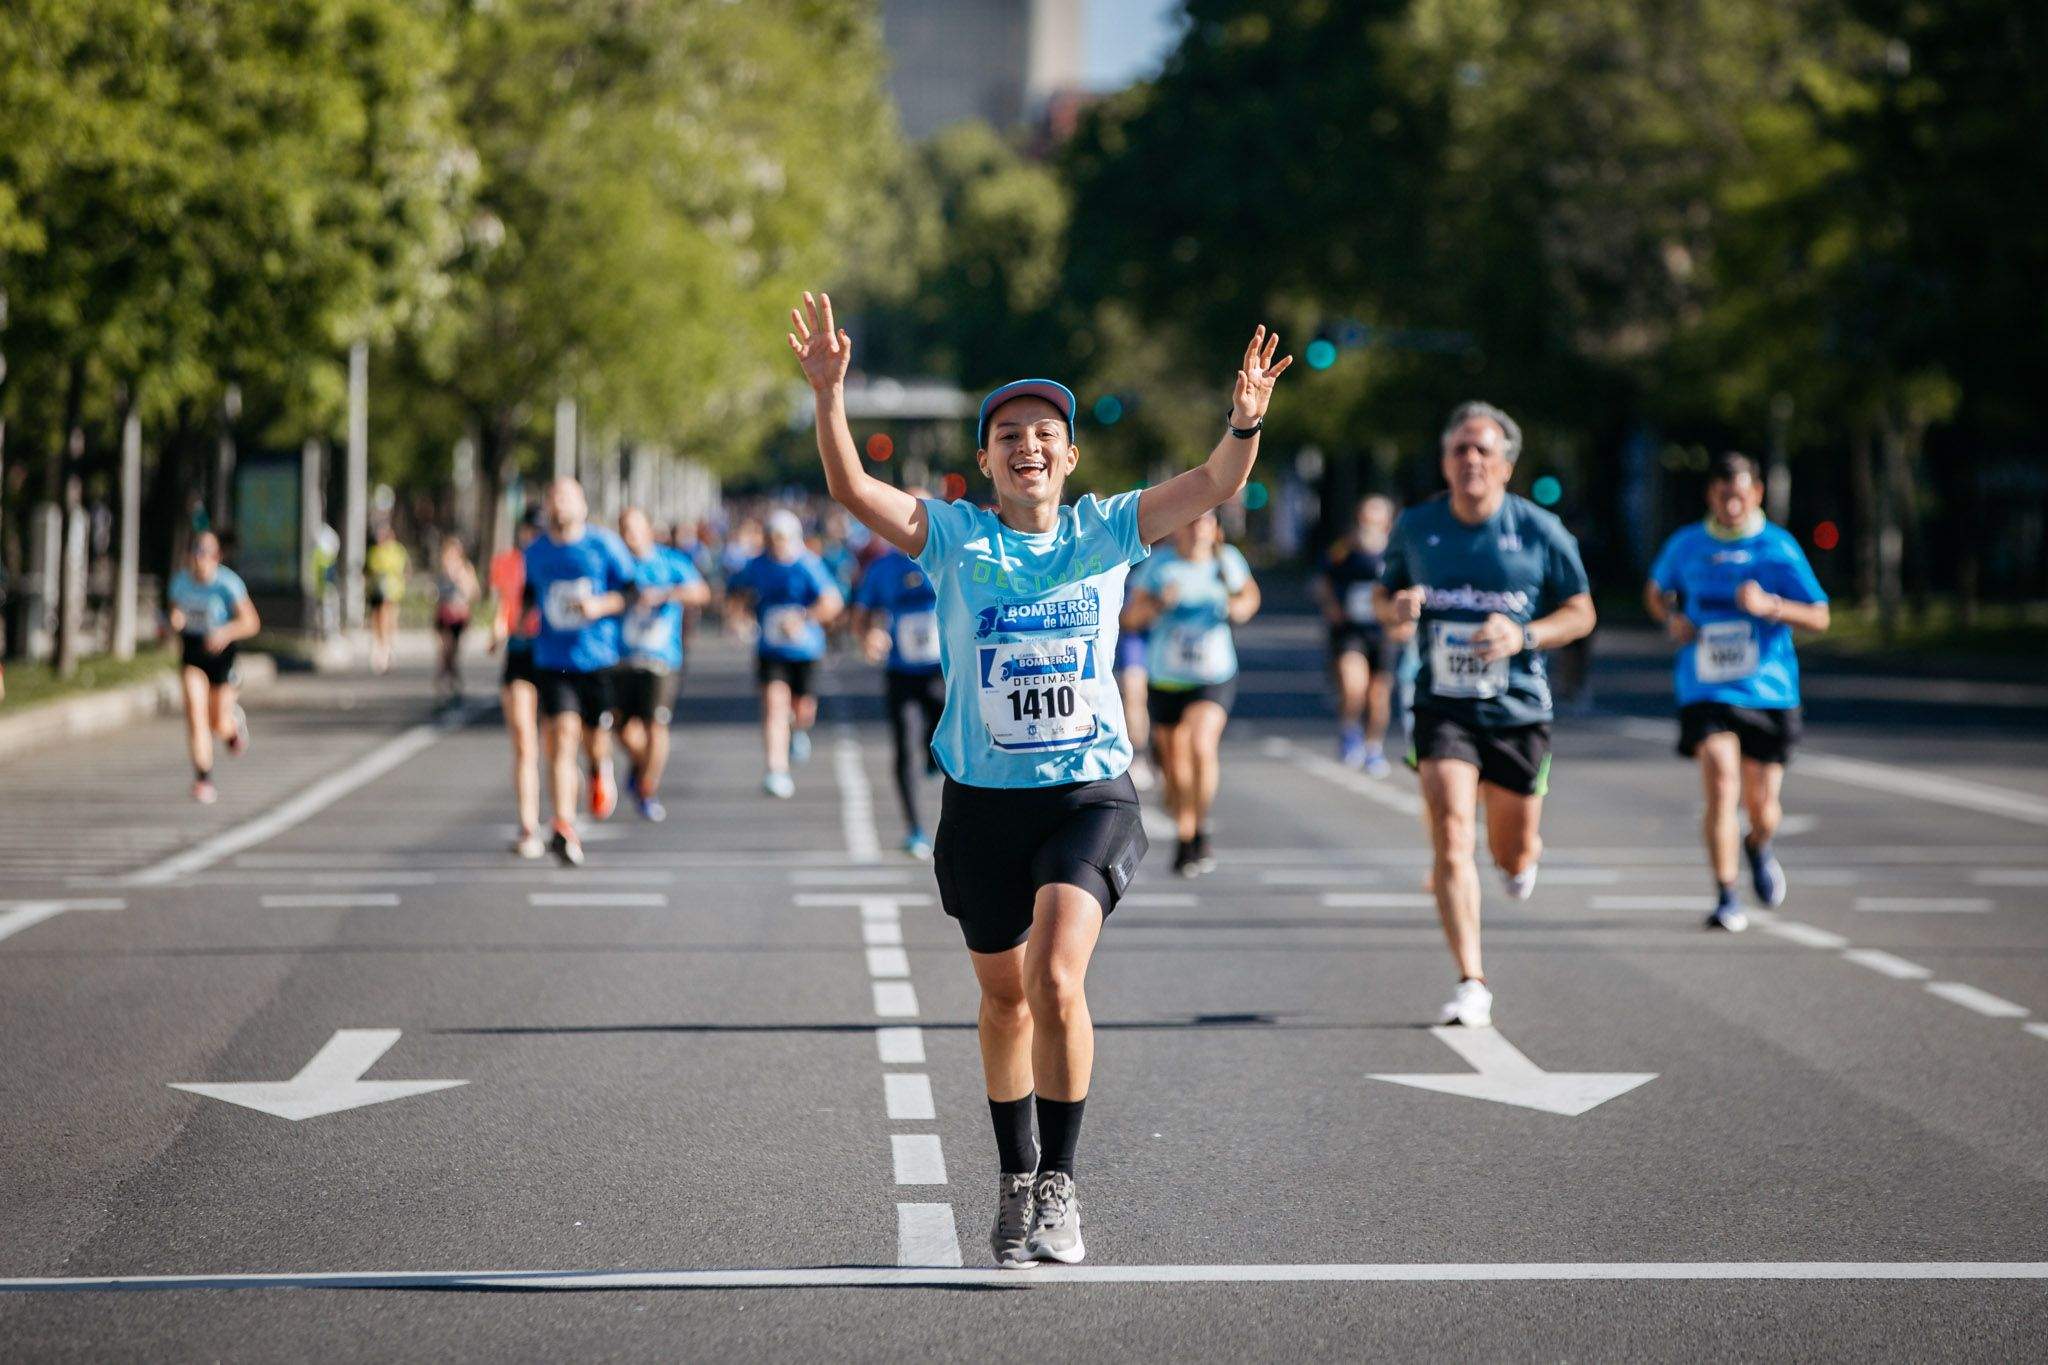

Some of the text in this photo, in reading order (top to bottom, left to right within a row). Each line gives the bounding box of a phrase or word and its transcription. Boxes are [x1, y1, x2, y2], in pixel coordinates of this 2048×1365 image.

[972, 553, 1104, 594] DECIMAS
[1008, 599, 1098, 618] BOMBEROS
[1043, 611, 1098, 629] de MADRID
[1019, 655, 1076, 668] BOMBEROS
[1013, 673, 1077, 687] DECIMAS
[1007, 685, 1075, 721] 1410
